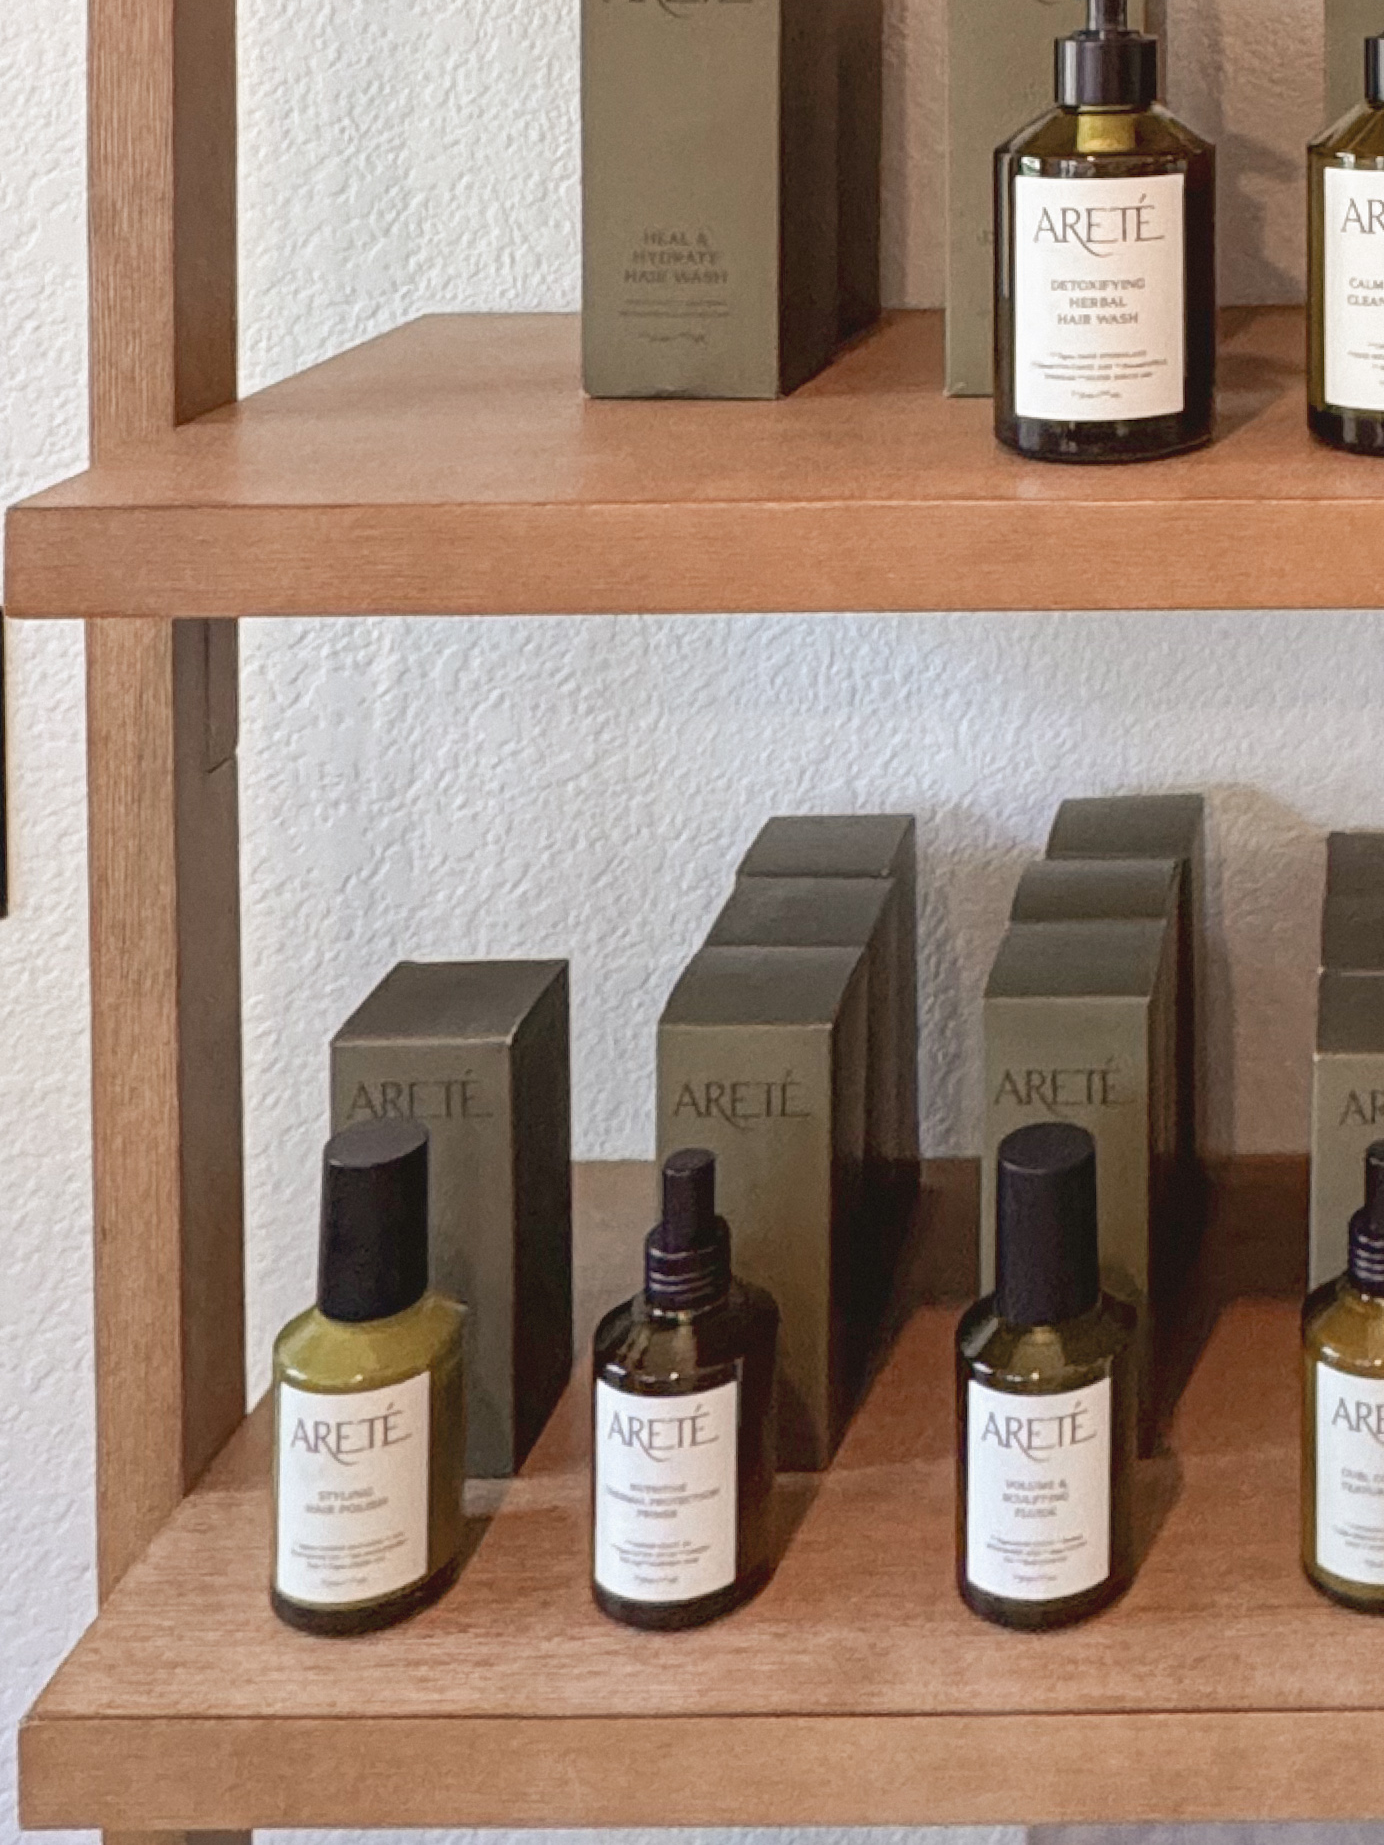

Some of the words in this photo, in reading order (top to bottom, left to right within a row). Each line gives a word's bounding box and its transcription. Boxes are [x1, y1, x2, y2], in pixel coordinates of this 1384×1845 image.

[1033, 193, 1165, 258] ARETÉ
[1051, 277, 1146, 291] DETOXIFYING
[1069, 296, 1128, 308] HERBAL
[1348, 276, 1384, 290] CALM
[1058, 313, 1092, 325] HAIR
[1096, 312, 1139, 325] WASH
[673, 1069, 812, 1132] ARETÉ
[994, 1055, 1139, 1119] ARETÉ
[290, 1402, 412, 1466] ARETÉ
[608, 1402, 719, 1462] ARETÉ
[981, 1400, 1097, 1463] ARETÉ
